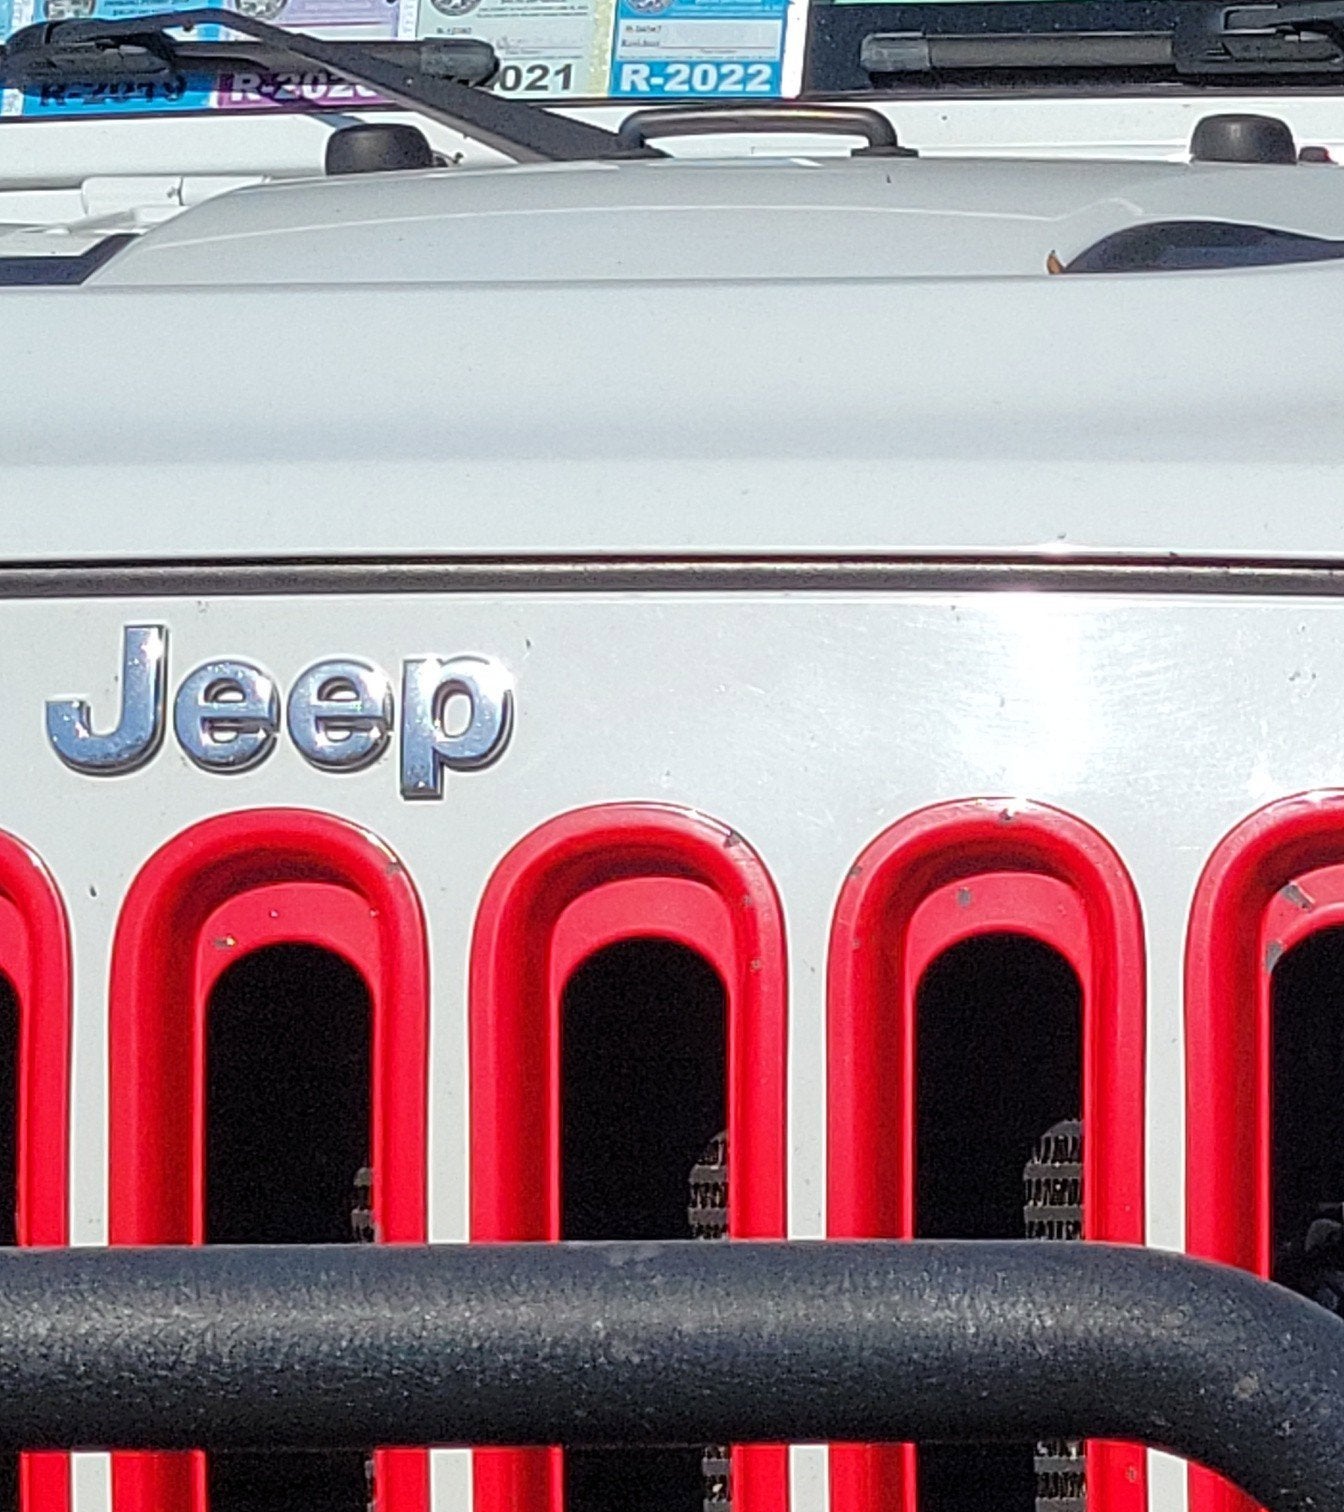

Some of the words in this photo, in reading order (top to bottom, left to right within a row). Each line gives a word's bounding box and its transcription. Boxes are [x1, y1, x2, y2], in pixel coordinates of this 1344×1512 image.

[486, 63, 573, 92] 021
[620, 63, 772, 92] R-2022
[46, 622, 514, 800] Jeep
